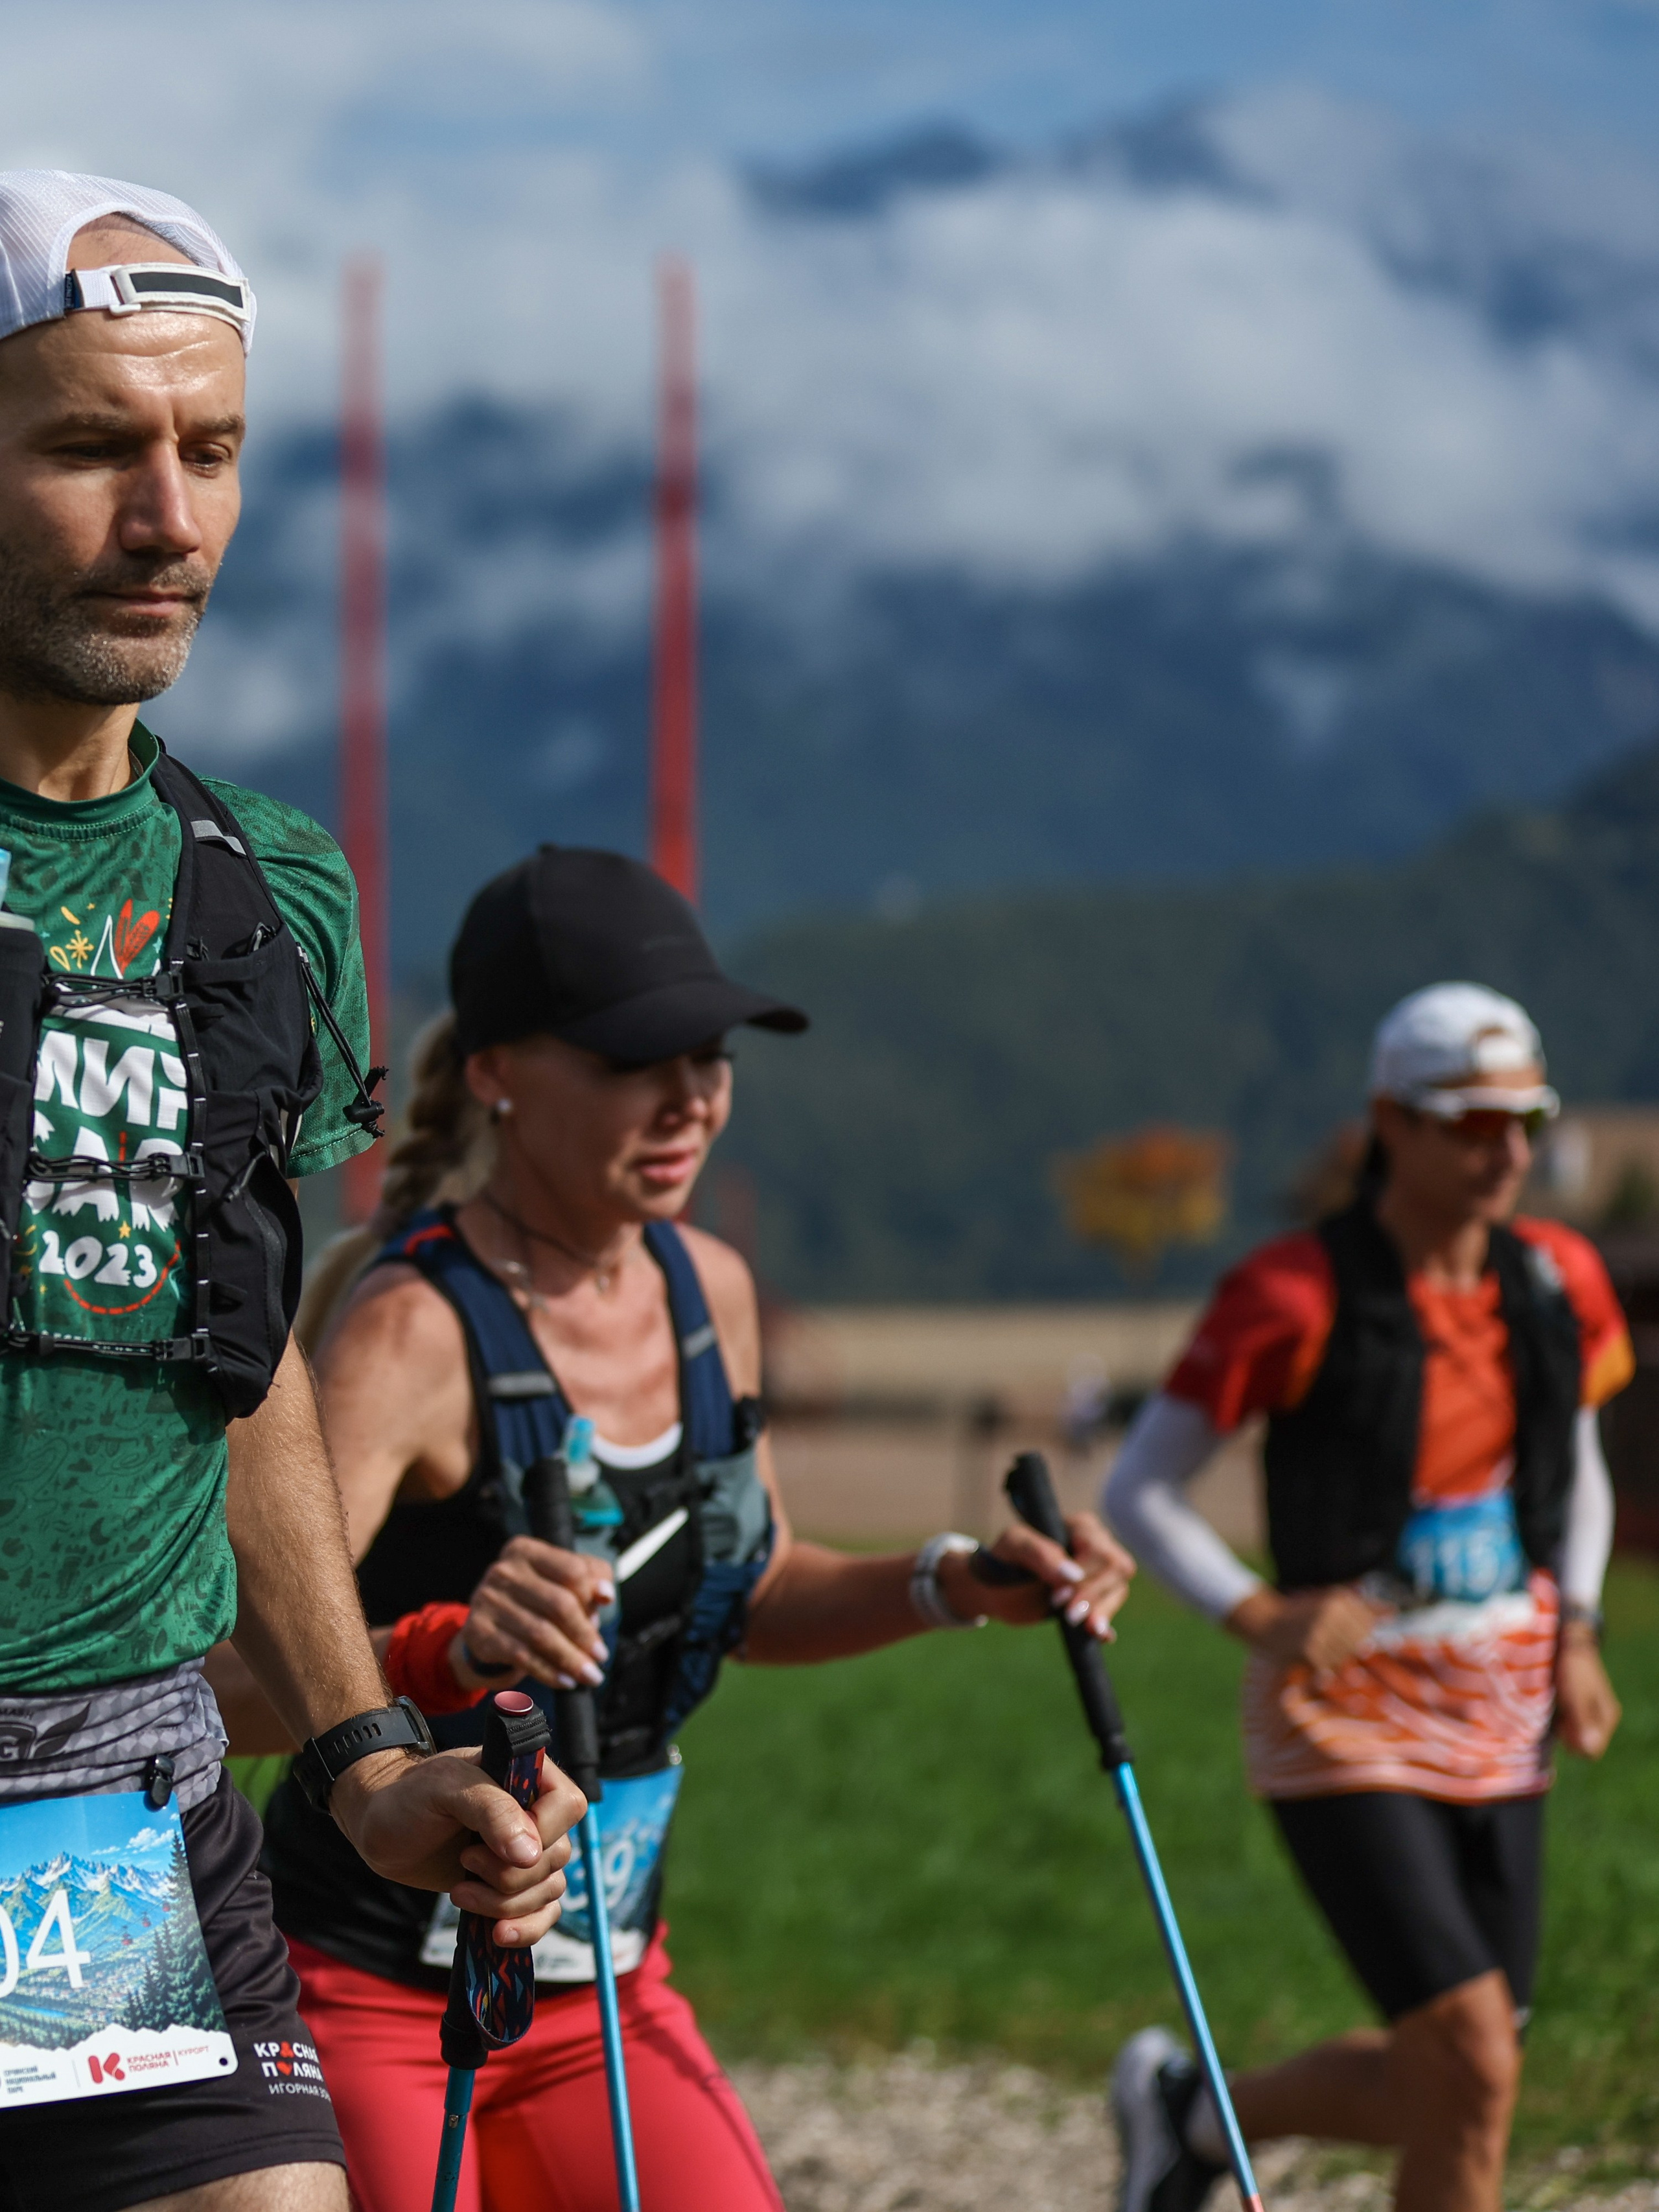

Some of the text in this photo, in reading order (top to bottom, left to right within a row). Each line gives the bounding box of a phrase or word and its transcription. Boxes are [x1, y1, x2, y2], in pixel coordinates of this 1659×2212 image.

[39, 1229, 157, 1288] 2023
[177, 2045, 209, 2056] КУРОРТ
[127, 2051, 171, 2064] КРАСНАЯ
[128, 2060, 169, 2073] ПОЛЯНА
